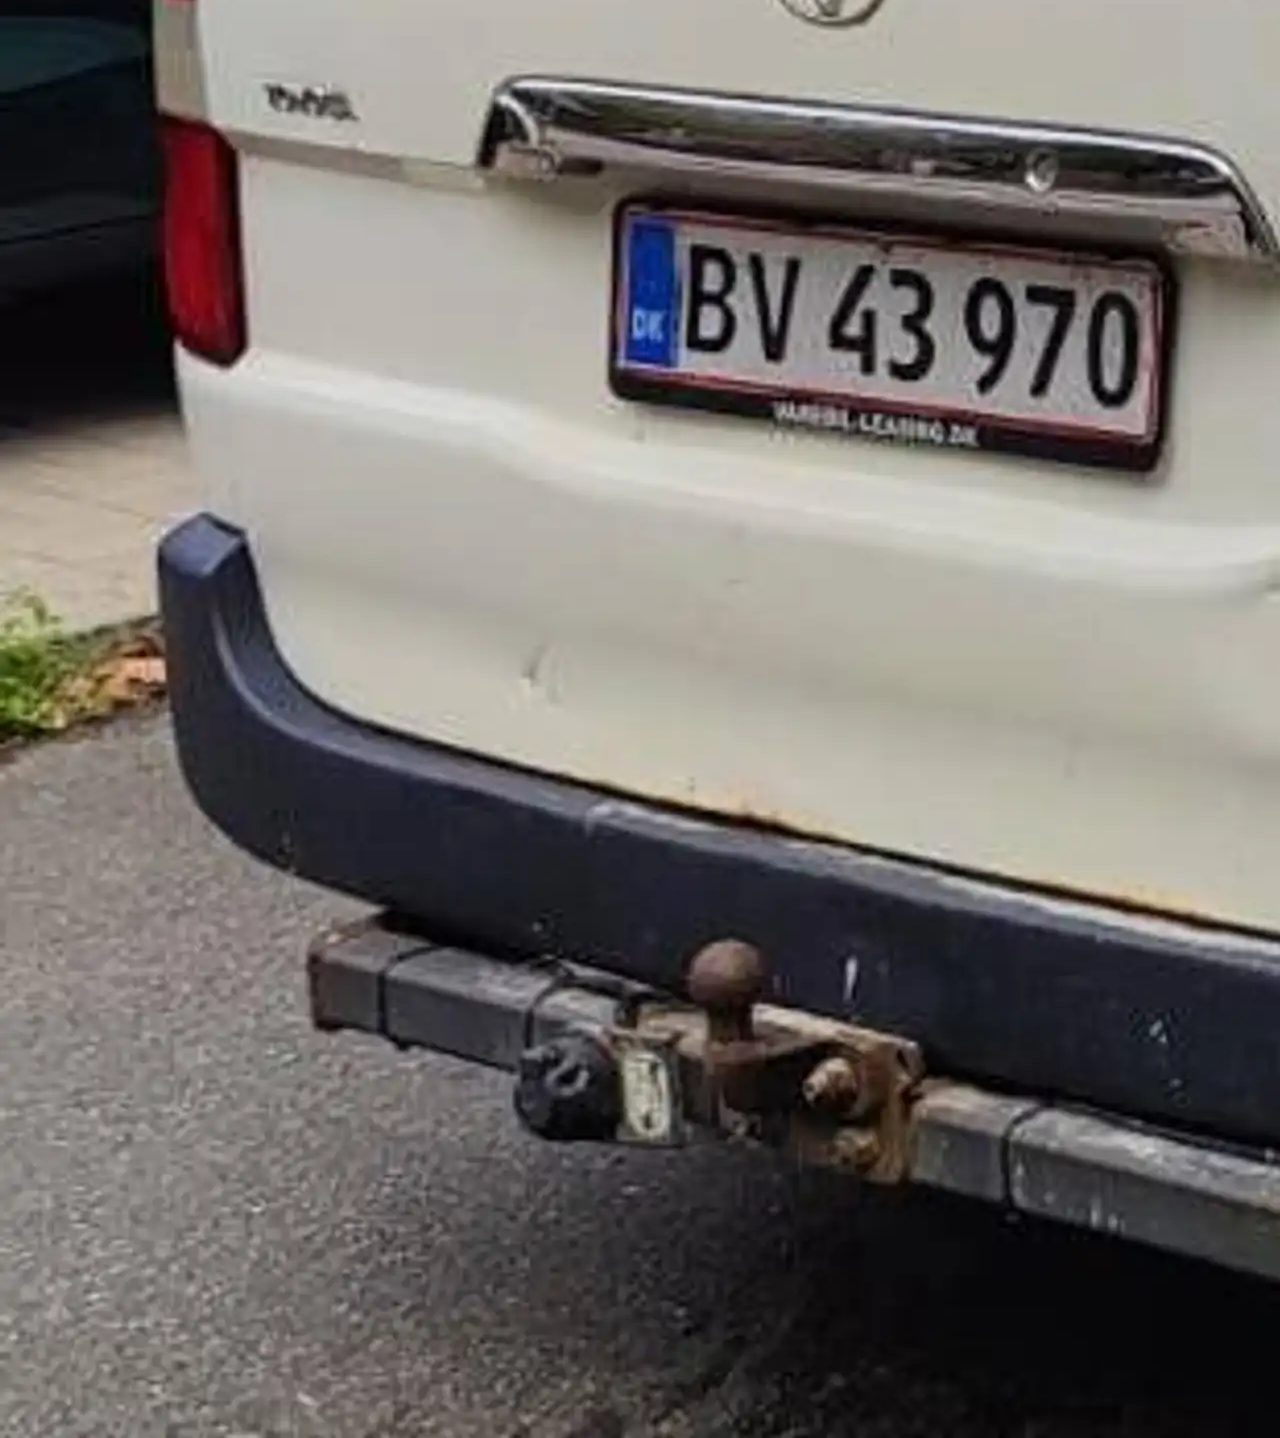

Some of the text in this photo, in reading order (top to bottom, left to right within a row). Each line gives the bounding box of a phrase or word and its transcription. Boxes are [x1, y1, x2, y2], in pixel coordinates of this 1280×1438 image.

[633, 306, 664, 342] DK
[685, 244, 1138, 408] BV 43 970
